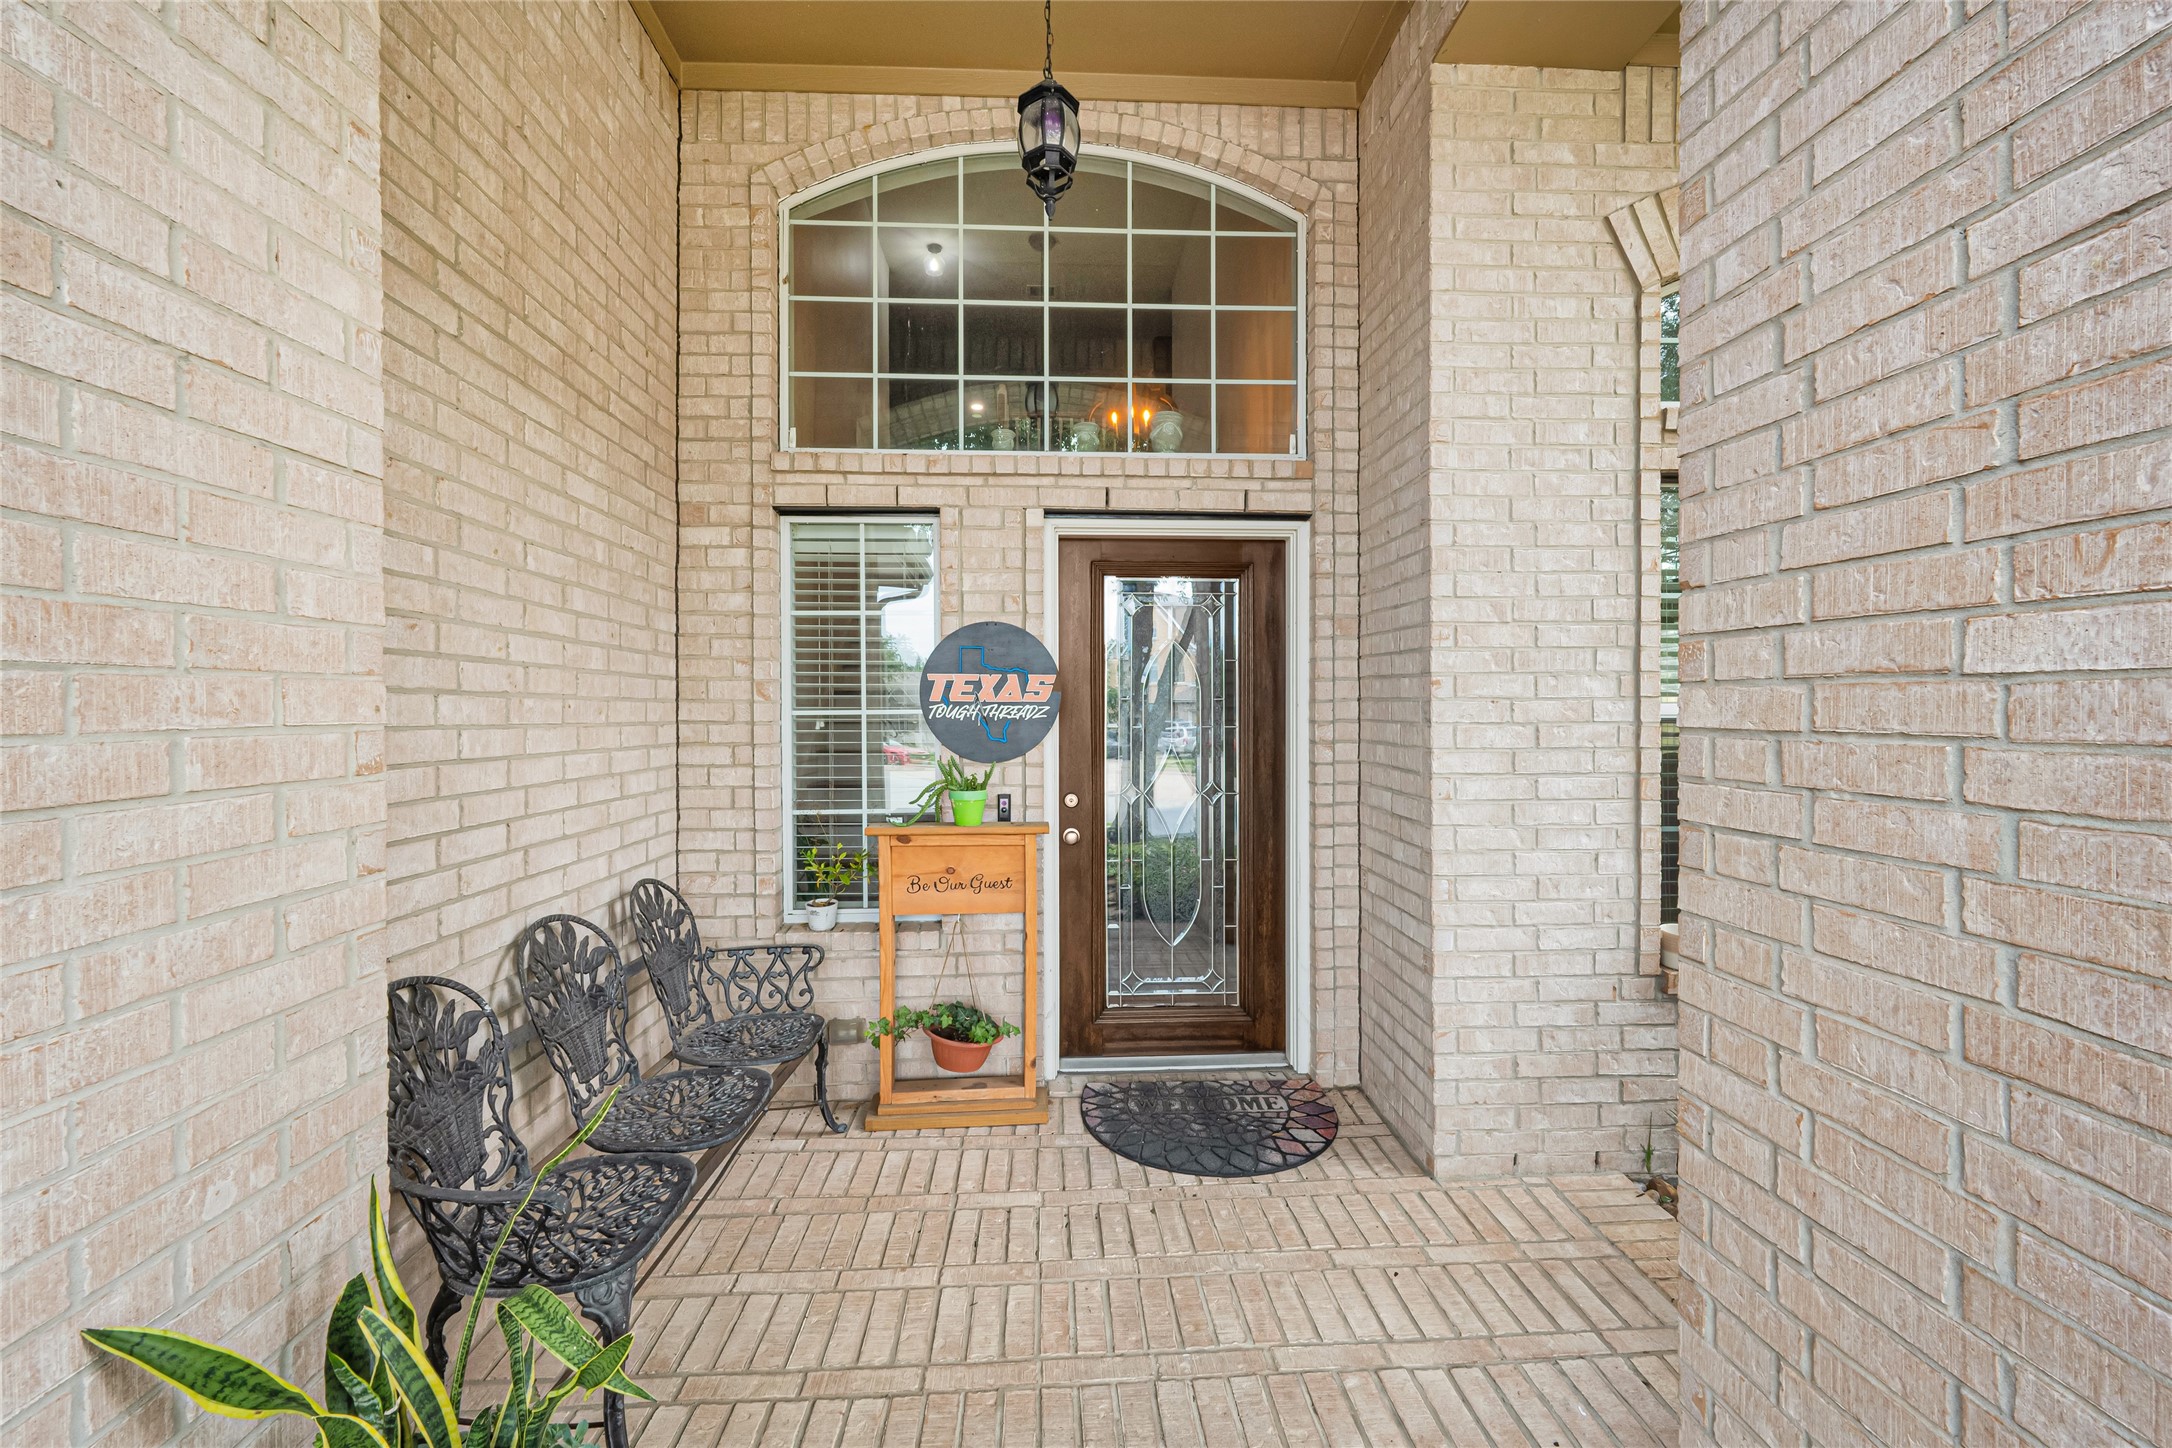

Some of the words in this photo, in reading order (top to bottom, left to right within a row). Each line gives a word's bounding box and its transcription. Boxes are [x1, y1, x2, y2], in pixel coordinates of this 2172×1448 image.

[927, 673, 1057, 702] TEXAS
[929, 704, 981, 721] TOUGH
[982, 704, 1051, 721] THREADZ
[906, 875, 930, 894] Be
[933, 876, 967, 893] Our
[970, 873, 1013, 894] Guest
